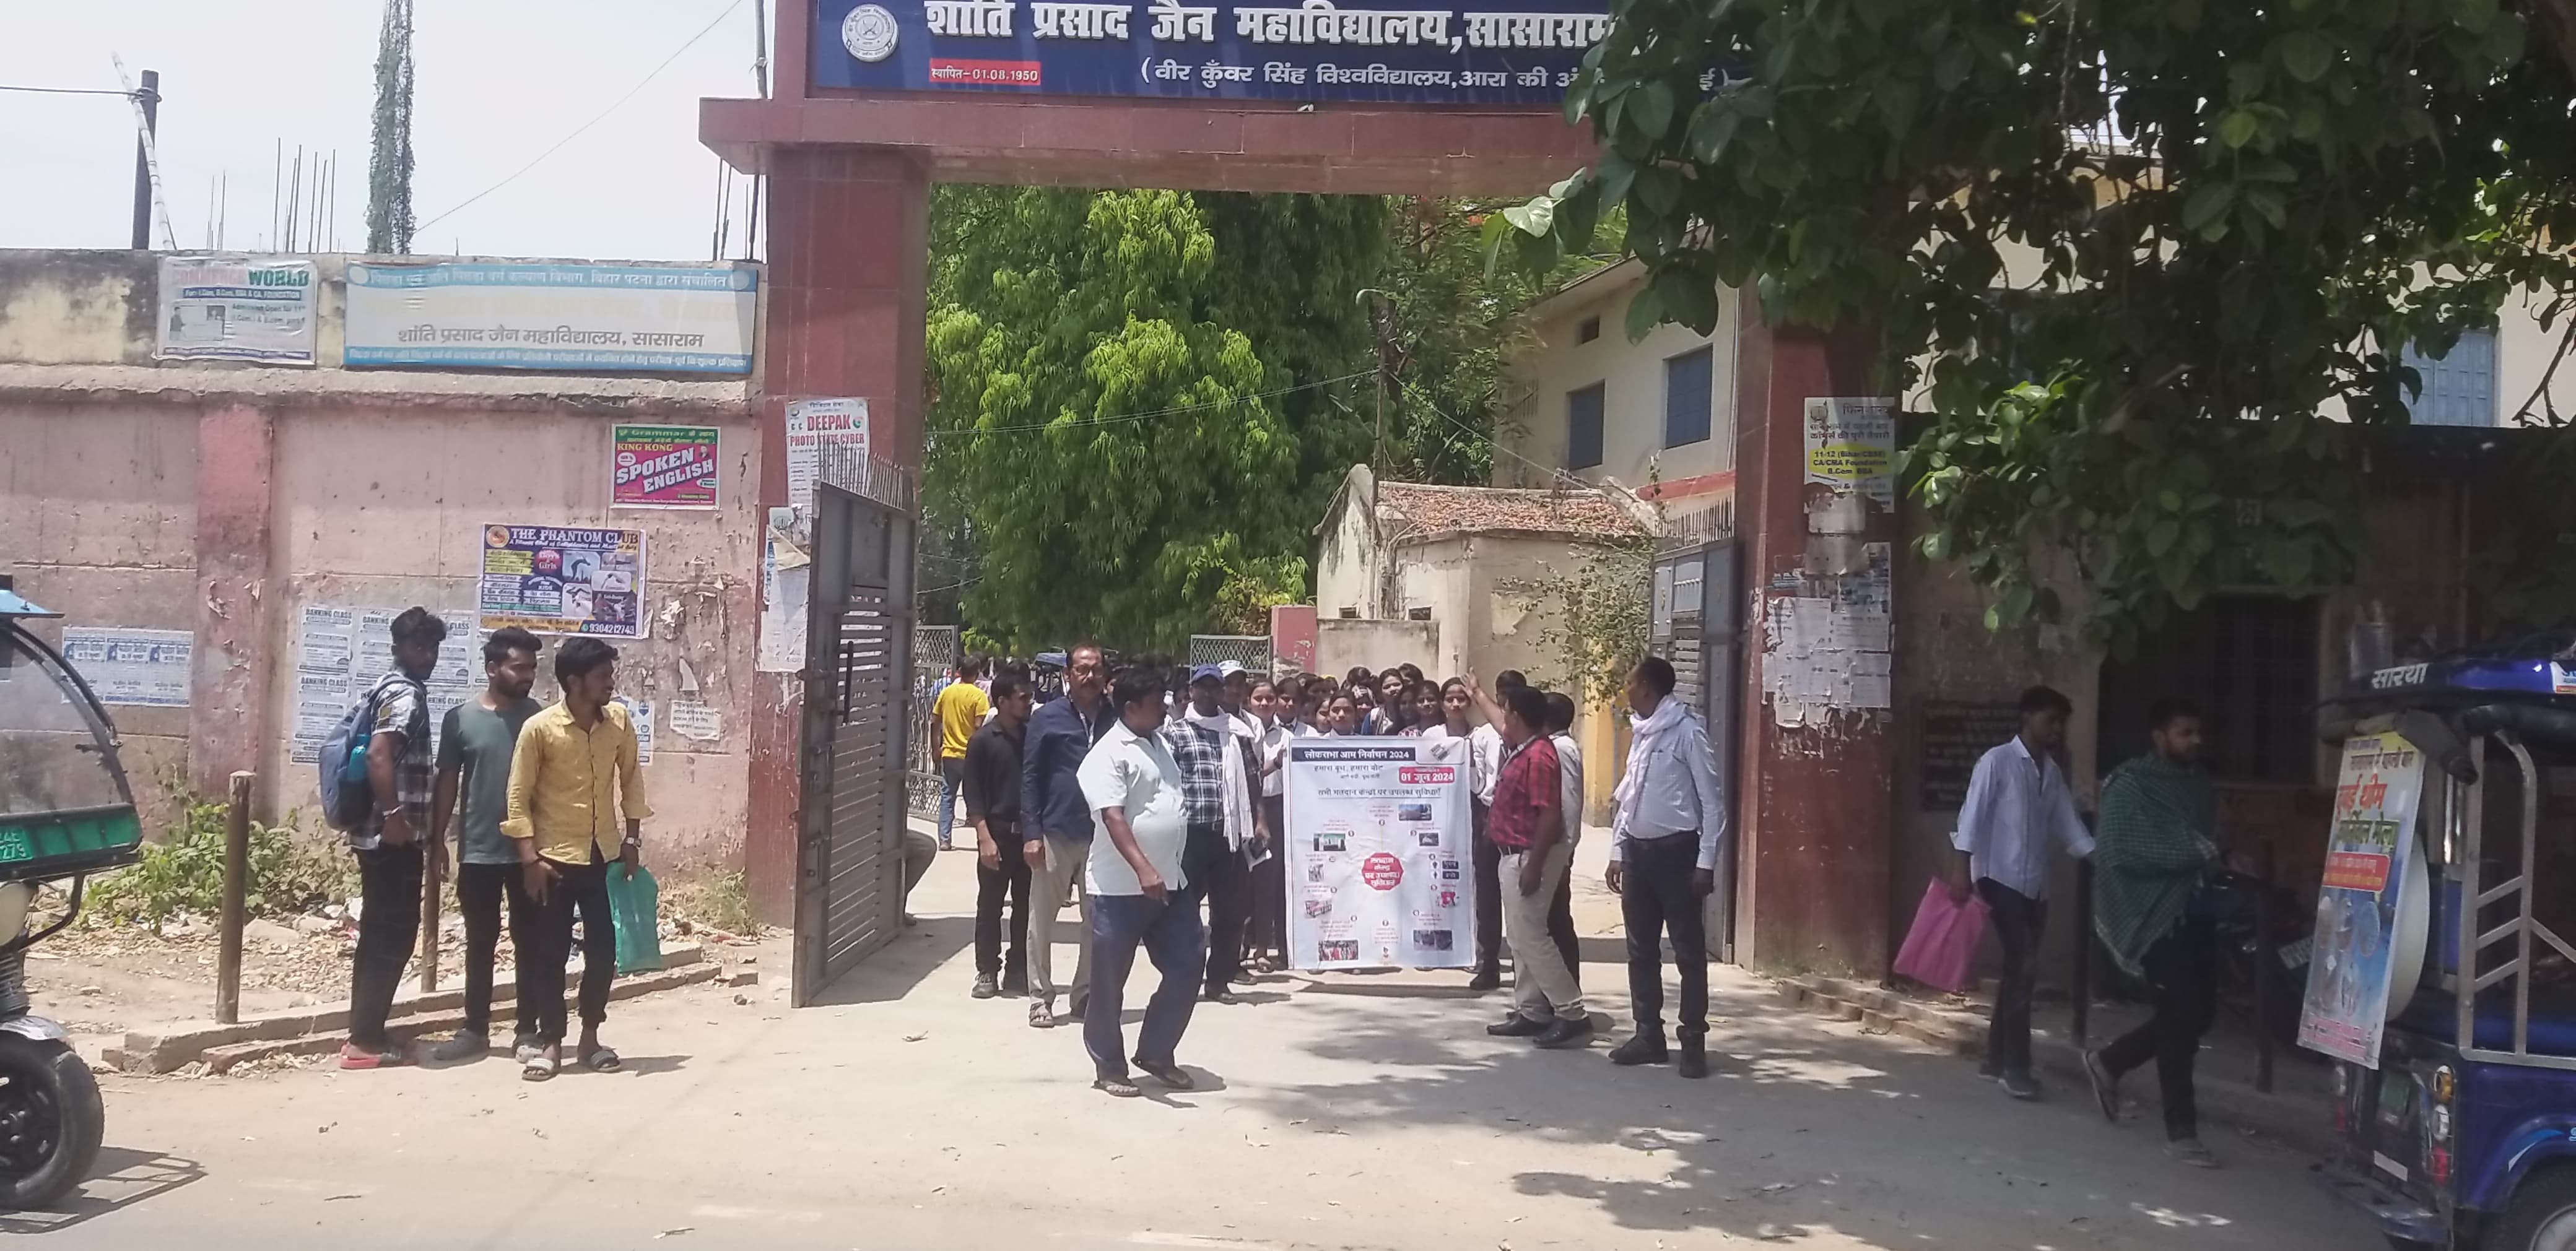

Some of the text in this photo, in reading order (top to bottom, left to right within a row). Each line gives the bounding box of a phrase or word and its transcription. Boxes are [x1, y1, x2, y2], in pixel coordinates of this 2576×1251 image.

[924, 0, 1016, 37] शाति
[1030, 4, 1132, 40] प्रसाद
[1148, 0, 1217, 42] जैन
[1201, 59, 1255, 89] कुँवर
[1263, 61, 1308, 84] सिंह
[1516, 66, 1549, 87] की
[249, 270, 309, 287] WORLD
[624, 272, 652, 286] पटना
[681, 271, 728, 287] संचालित
[399, 323, 435, 342] शांति
[441, 328, 484, 344] प्रसाद
[632, 332, 705, 347] सासाराम
[807, 414, 851, 431] DEEPAK
[617, 443, 673, 451] KING KONG
[790, 435, 815, 446] PHOTO
[840, 433, 865, 444] CYBER
[616, 447, 694, 484] SPOKEN
[643, 459, 714, 493] ENGLISH
[511, 528, 638, 544] THE PHANTOM CLUB
[1339, 750, 1356, 759] आम
[1357, 748, 1387, 760] निर्वाचन
[1389, 751, 1409, 759] 2024
[1401, 773, 1454, 784] 01 जून 2024
[1333, 788, 1356, 796] मतदान
